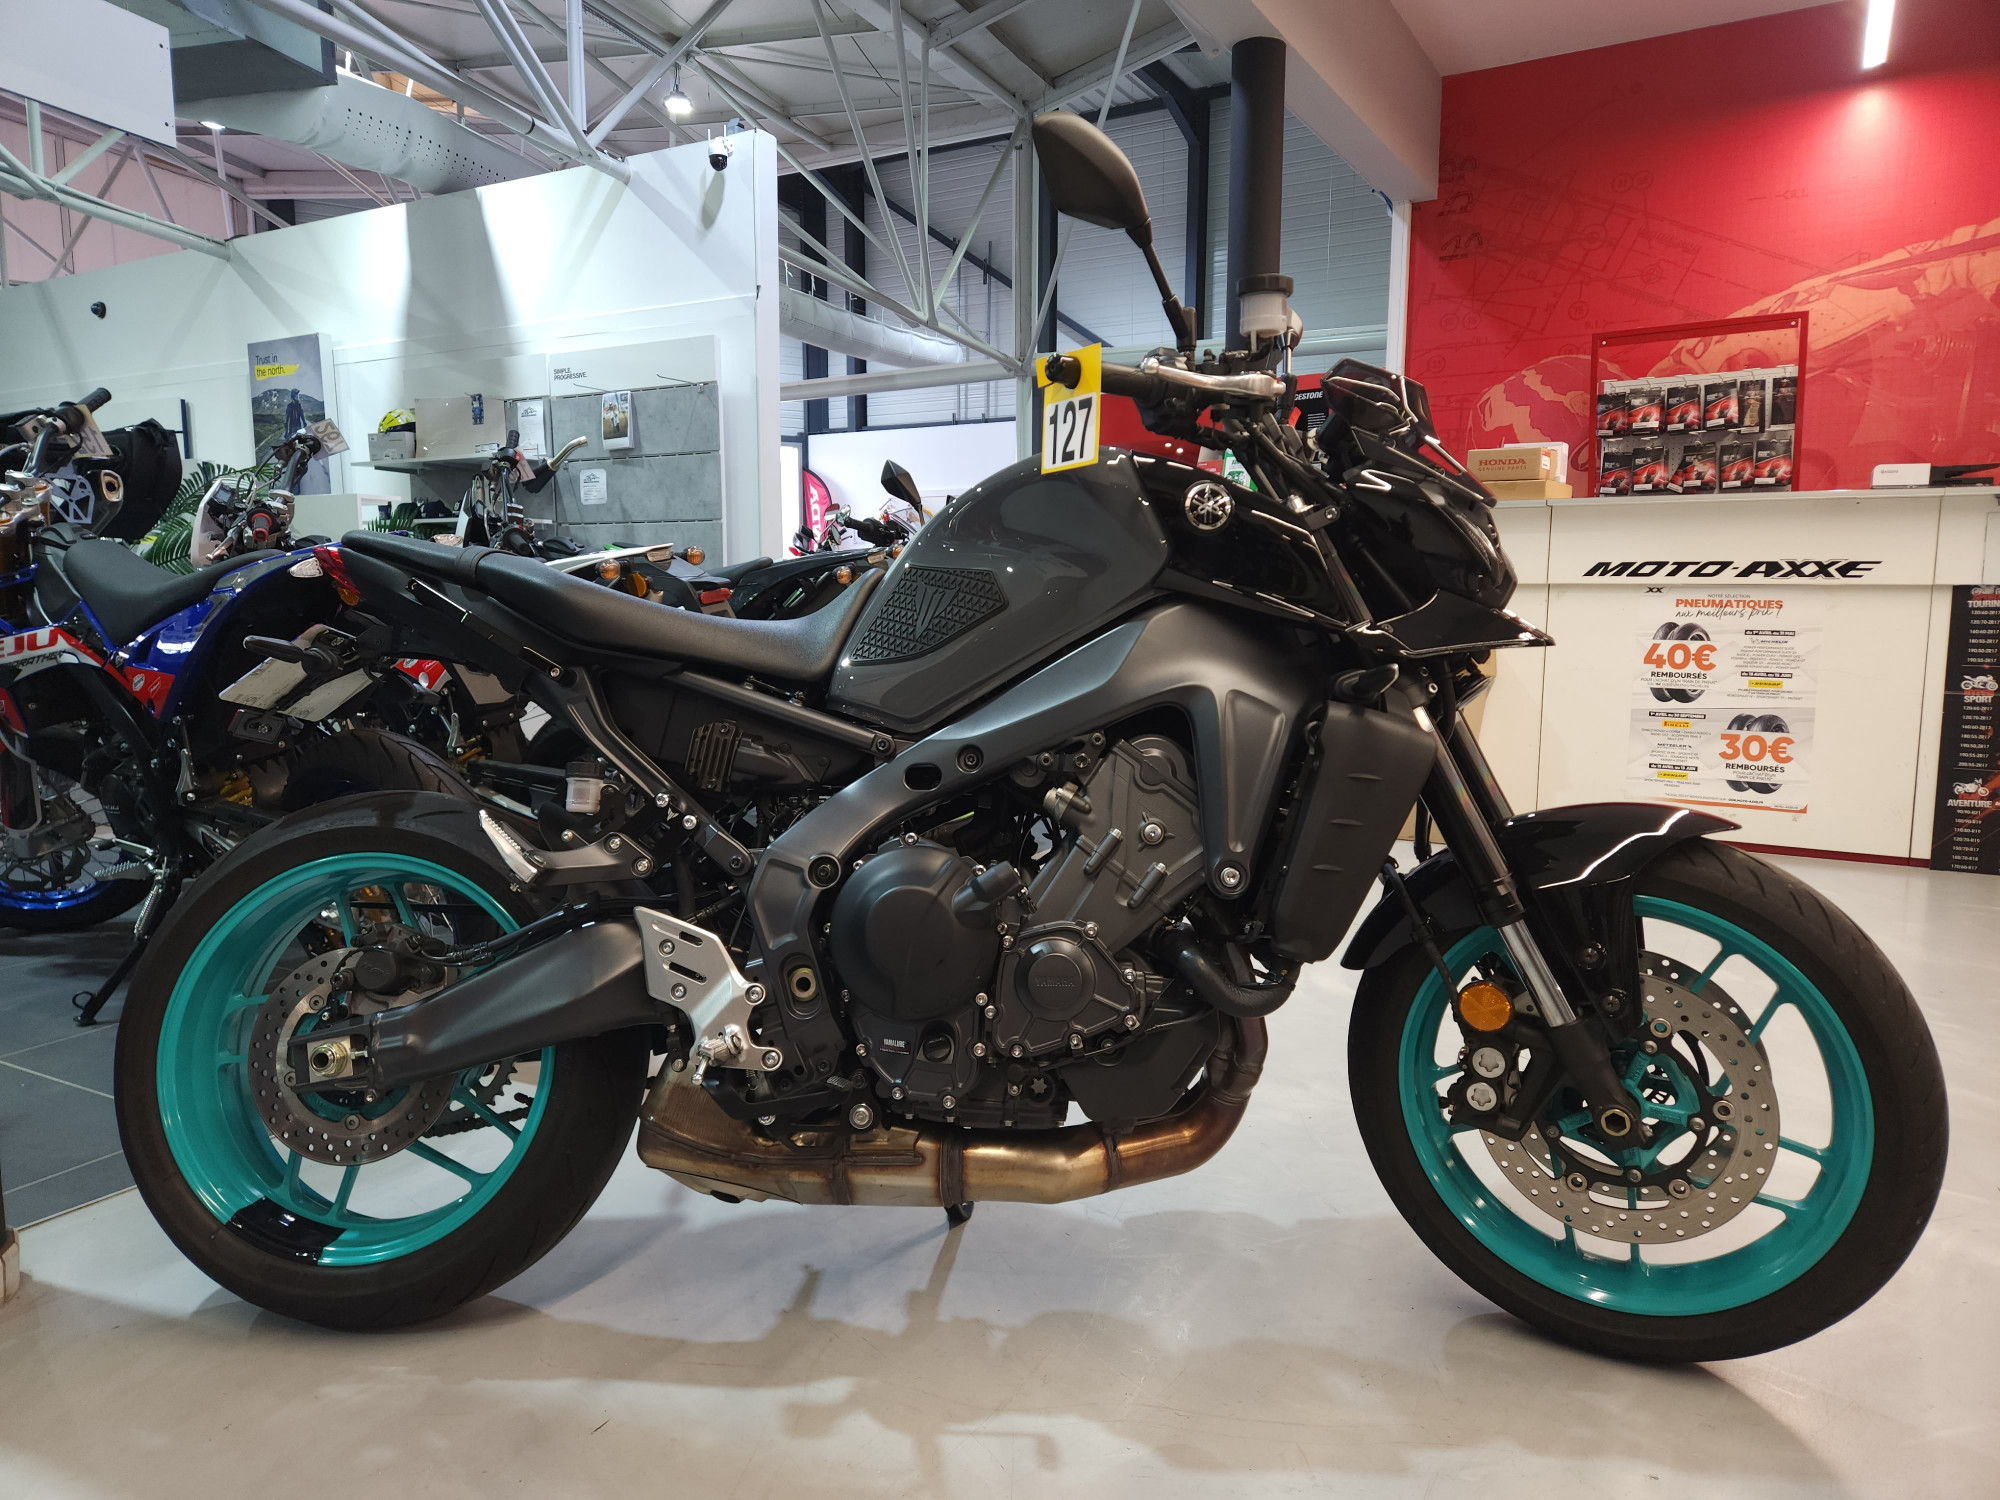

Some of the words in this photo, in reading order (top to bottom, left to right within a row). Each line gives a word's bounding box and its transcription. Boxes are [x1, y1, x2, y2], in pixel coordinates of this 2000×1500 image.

[256, 355, 270, 364] Trust
[272, 354, 278, 362] in
[256, 368, 266, 377] the
[268, 365, 286, 376] north.
[1050, 397, 1092, 465] 127
[1479, 458, 1527, 466] HONDA
[1582, 560, 1883, 579] MOTO-AXXE
[1676, 599, 1783, 609] PNEUMATIQUES
[1675, 610, 1693, 618] aux
[1694, 606, 1744, 620] meilleurs
[1644, 643, 1718, 671] 40€
[1651, 671, 1708, 680] REMBOURSÉS
[1718, 734, 1795, 764] 30€
[1726, 763, 1785, 772] REMBOURSÉS
[1947, 799, 1992, 808] AVENTURE
[1034, 976, 1074, 987] YAMAHA
